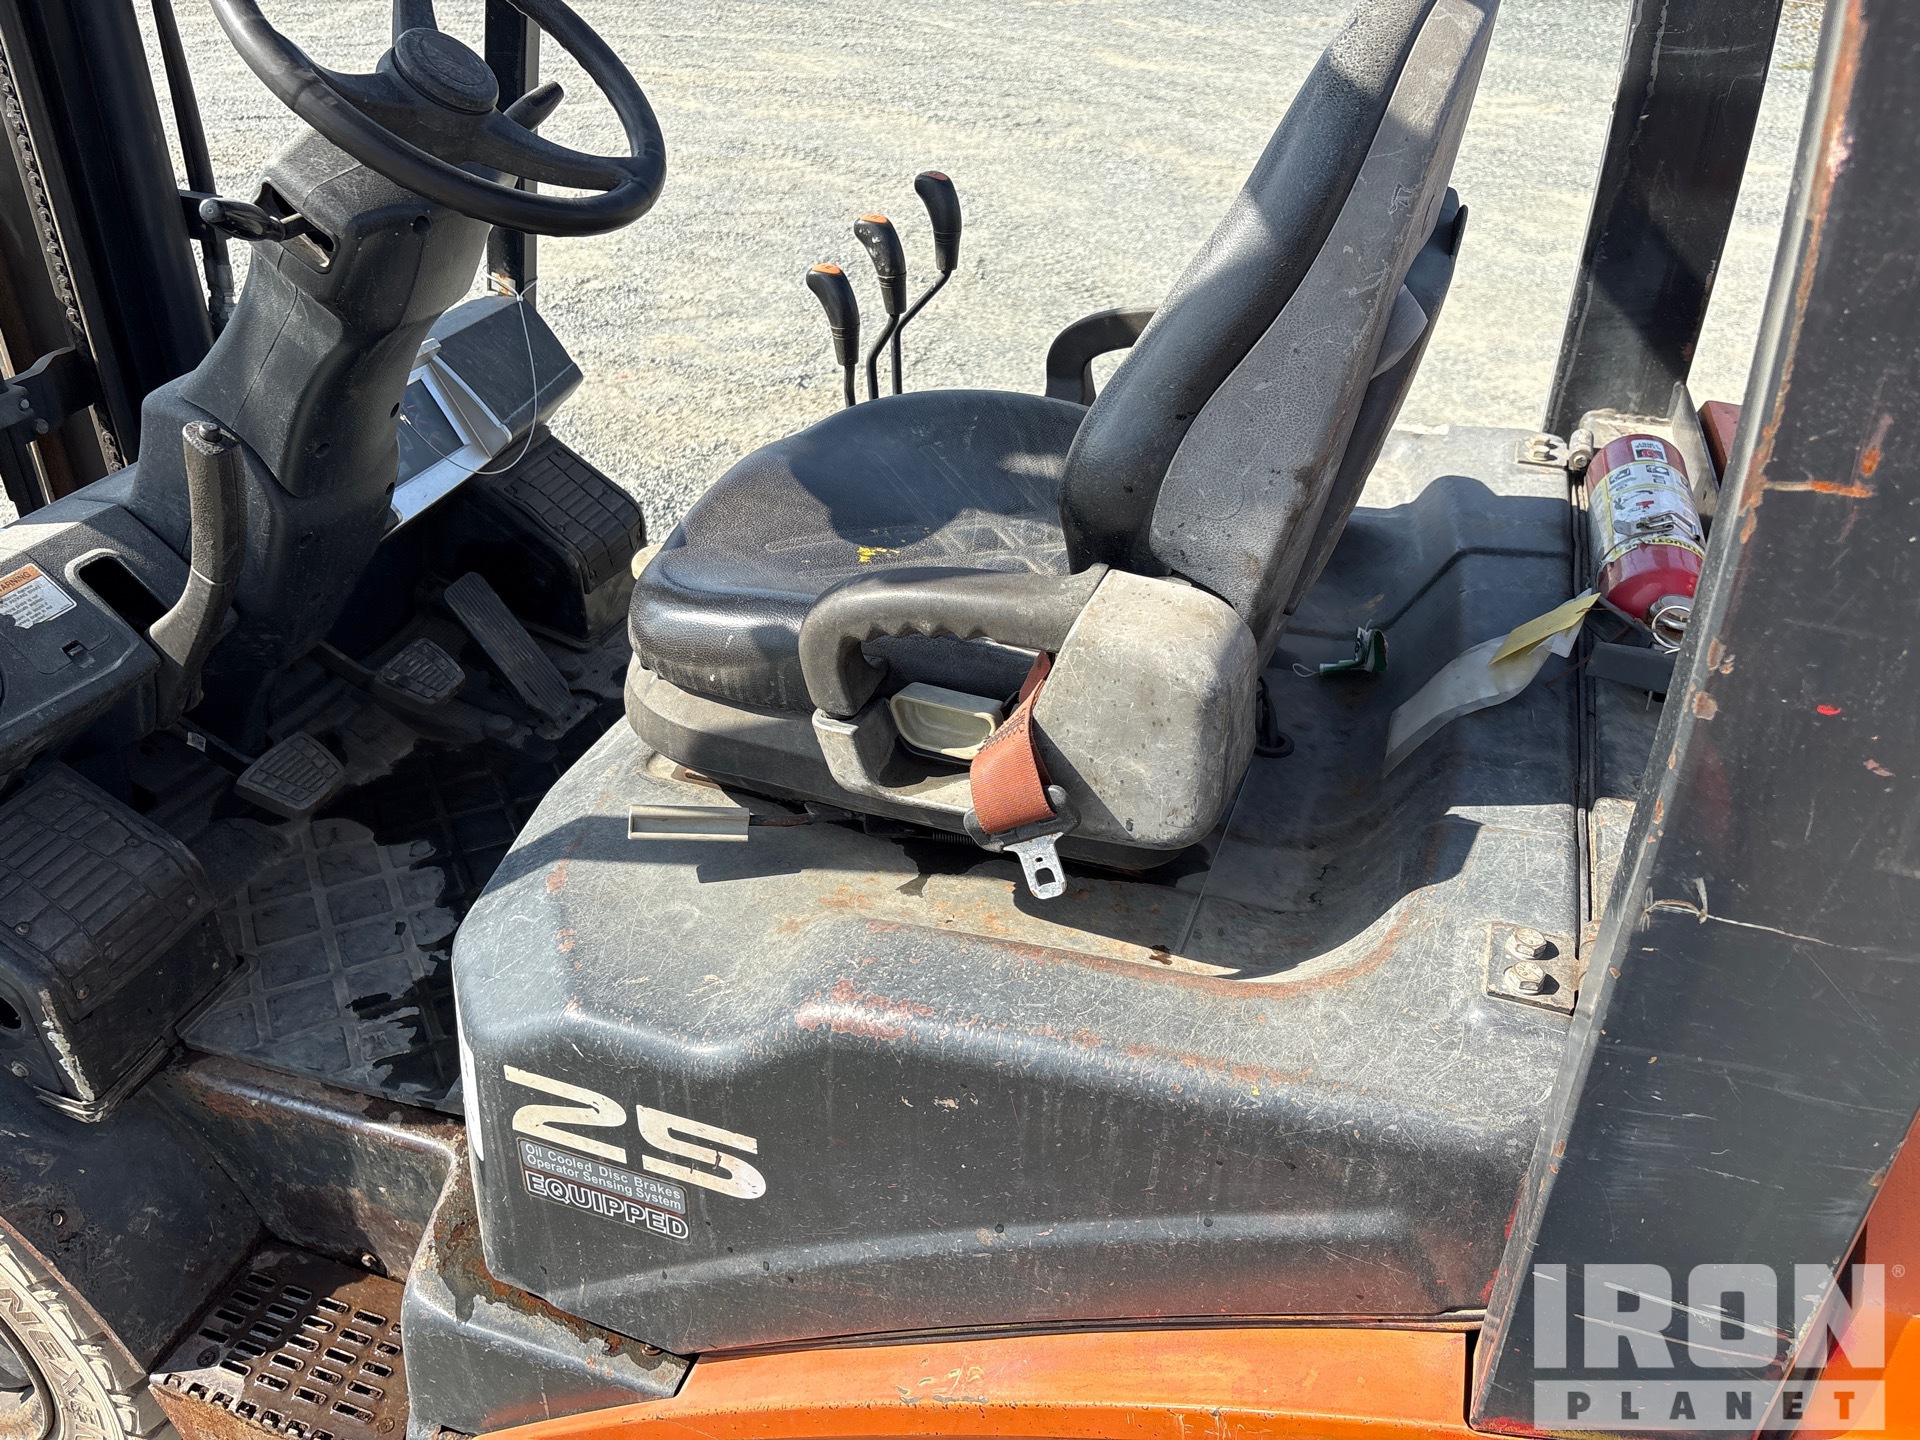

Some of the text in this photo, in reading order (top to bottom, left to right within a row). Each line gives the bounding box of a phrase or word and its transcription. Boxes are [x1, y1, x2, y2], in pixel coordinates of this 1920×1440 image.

[0, 571, 31, 592] ARNING
[503, 1064, 767, 1199] 25
[525, 1143, 681, 1199] Oil Cooled Disc Brakes
[527, 1154, 682, 1210] Operator Sensing System
[524, 1170, 689, 1239] EQUIPPED
